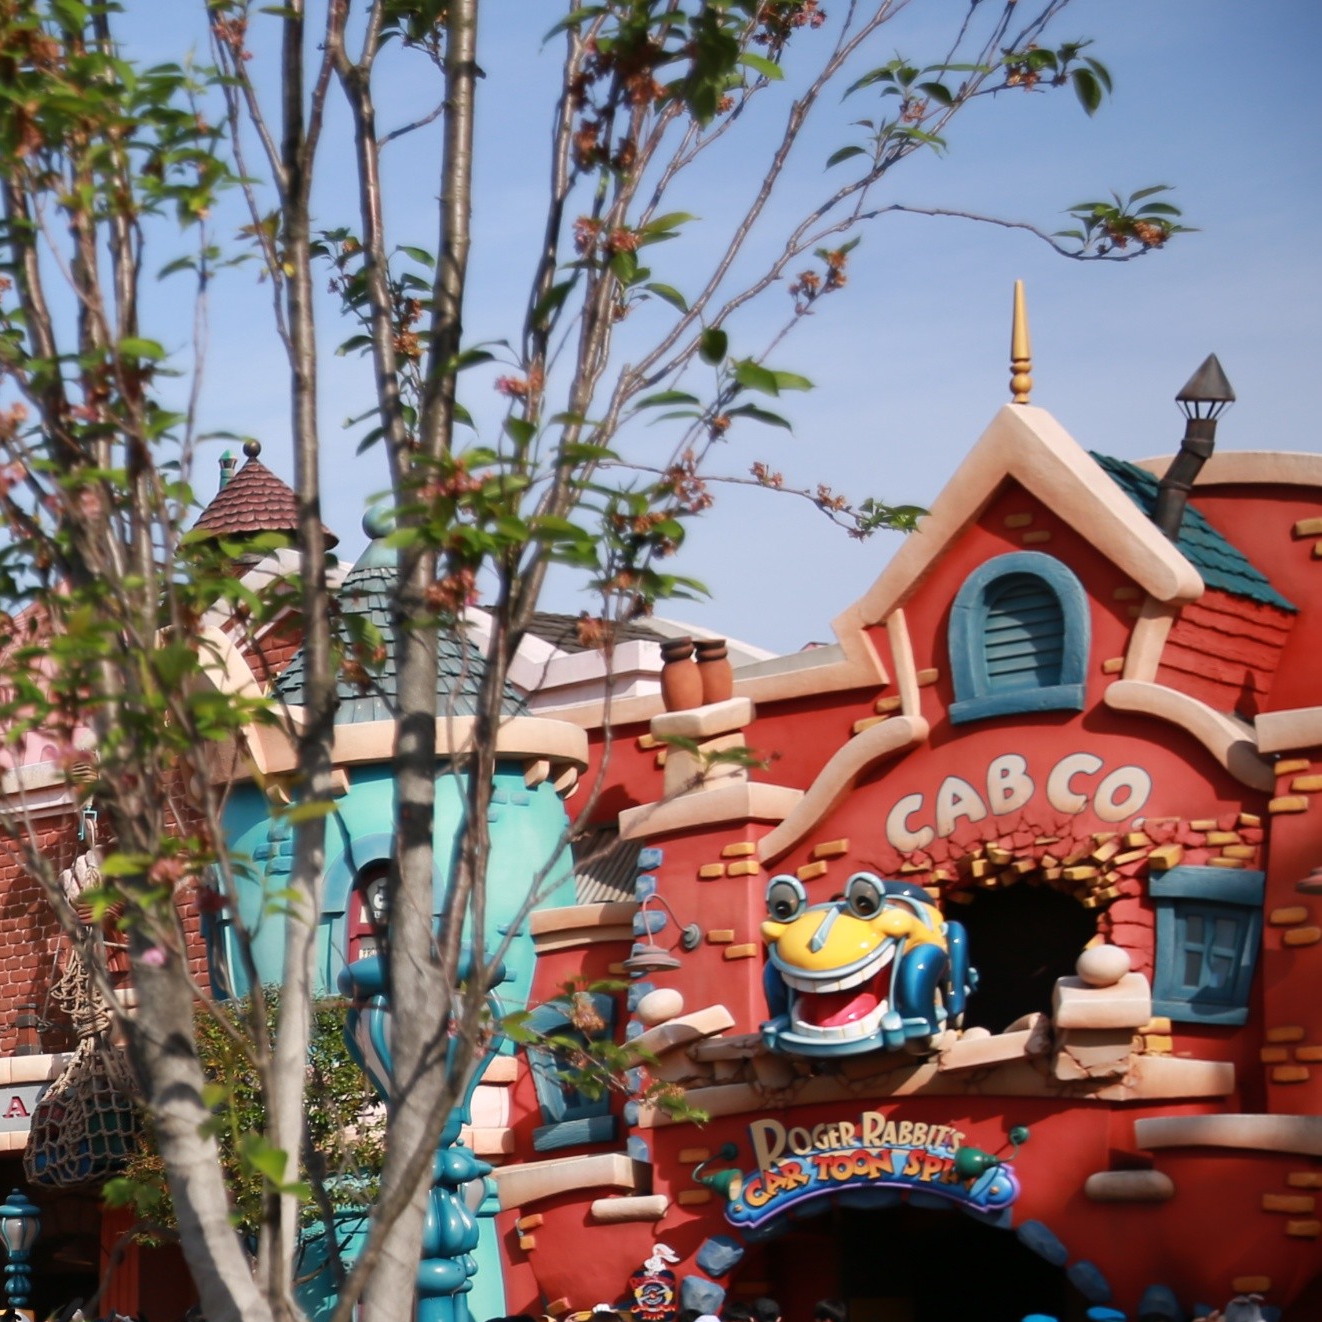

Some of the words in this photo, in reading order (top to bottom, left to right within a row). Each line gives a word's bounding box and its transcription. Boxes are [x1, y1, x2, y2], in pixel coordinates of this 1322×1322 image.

[886, 753, 1035, 853] CAB
[745, 1162, 809, 1206] CAR
[813, 1149, 892, 1181] TOON
[903, 1149, 977, 1191] SPI
[749, 1118, 855, 1189] ROGER
[862, 1111, 965, 1153] RABBIT'S
